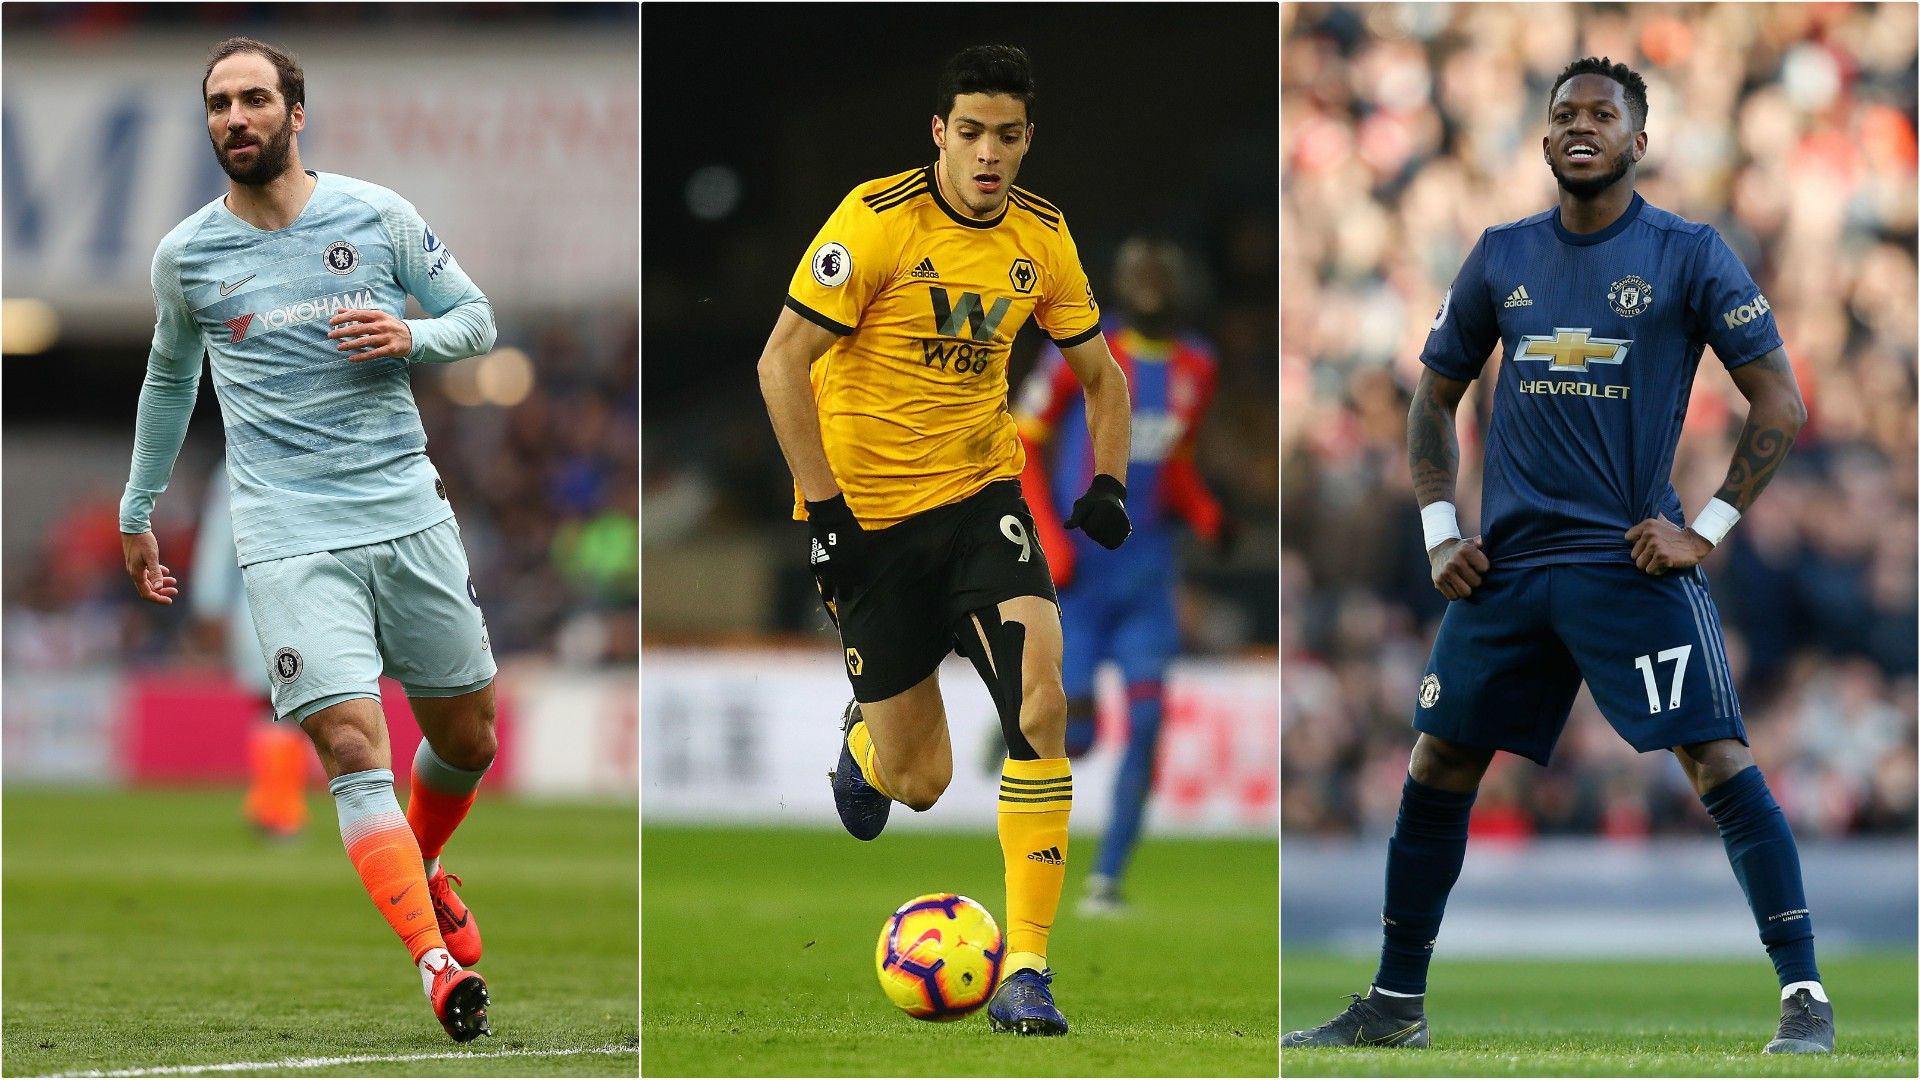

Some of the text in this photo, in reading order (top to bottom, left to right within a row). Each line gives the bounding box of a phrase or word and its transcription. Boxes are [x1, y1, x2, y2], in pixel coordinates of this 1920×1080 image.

[1614, 278, 1649, 293] MANCHESTER
[257, 290, 374, 330] YOKOHAMA
[1503, 299, 1533, 308] adidas
[1615, 306, 1640, 315] UNITED
[922, 339, 987, 375] W88
[828, 532, 837, 546] 9
[999, 514, 1030, 562] 9
[1635, 645, 1693, 714] 17
